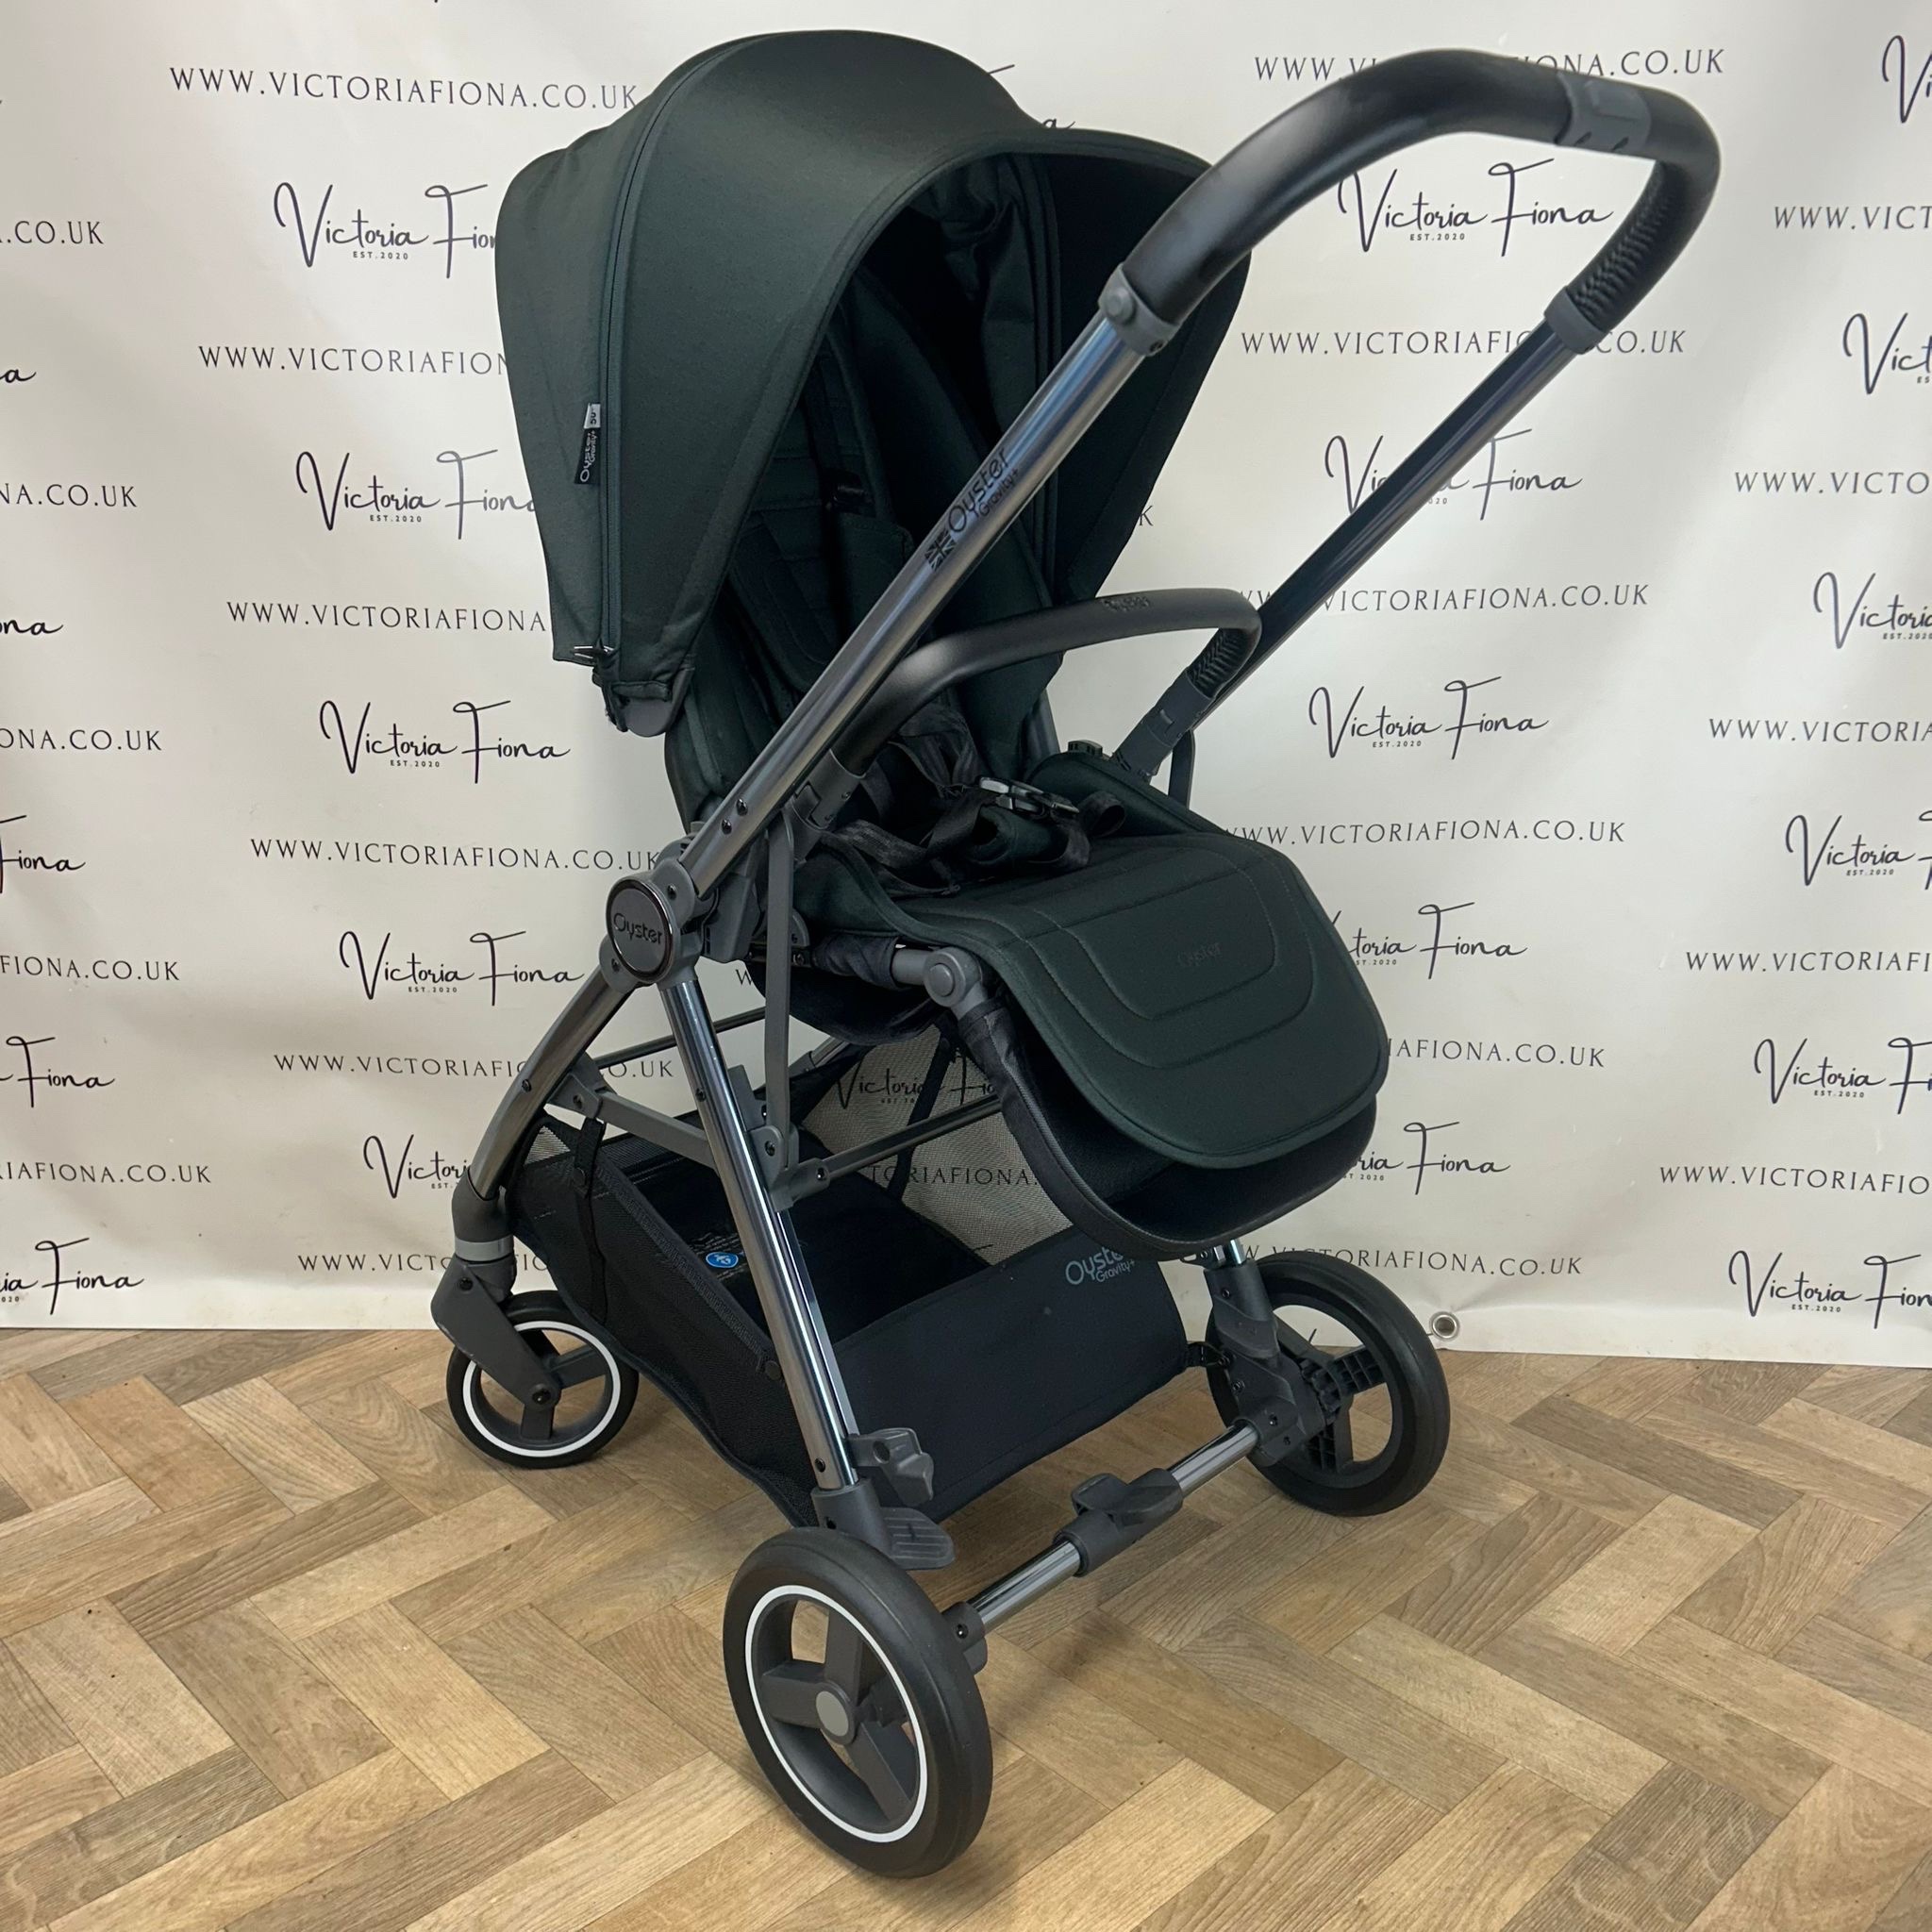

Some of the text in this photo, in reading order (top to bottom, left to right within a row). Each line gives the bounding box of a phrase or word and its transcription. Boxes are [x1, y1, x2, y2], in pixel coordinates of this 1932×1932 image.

[274, 182, 429, 268] Victoria
[1338, 158, 1614, 257] Victoria Fiona
[353, 251, 408, 260] EST.2020
[295, 451, 441, 531] Victoria
[948, 448, 1008, 532] Oyster
[1473, 428, 1583, 521] Fiona
[370, 514, 422, 523] EST.2020
[319, 700, 571, 784] Victoria Fiona
[1308, 676, 1549, 760] Victoria Fiona
[390, 759, 440, 768] EST.2020
[1785, 815, 1916, 887] Victoria
[614, 913, 662, 945] Oyster
[1418, 902, 1528, 979] Fiona
[339, 930, 585, 1007] Victoria Fiona
[7, 1036, 115, 1108] Fiona
[1754, 1038, 1887, 1105] Victoria
[1814, 1090, 1864, 1098] EST.2020
[1404, 1122, 1510, 1195] Fiona
[35, 1238, 144, 1316] Fiona
[1065, 1246, 1124, 1285] Oyste
[1095, 1261, 1135, 1283] Gravity+
[1728, 1250, 1863, 1317] Victoria
[1791, 1304, 1840, 1312] EST.2020
